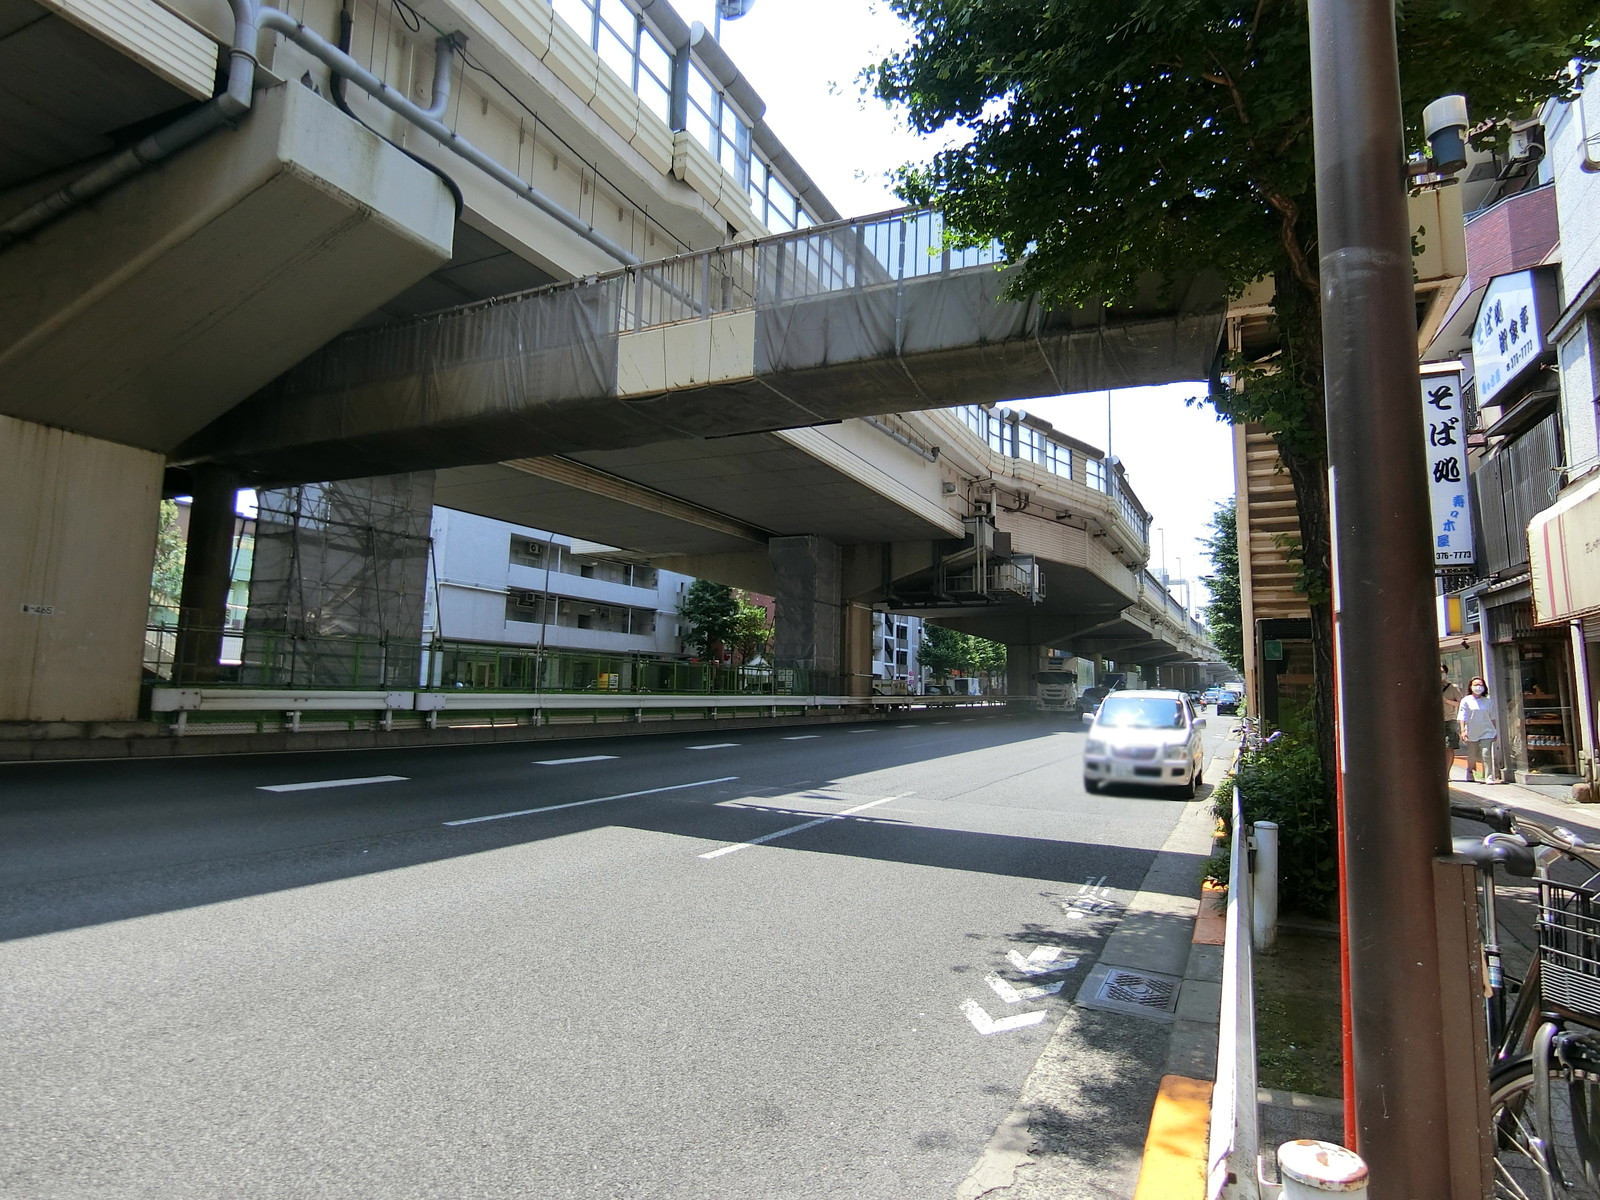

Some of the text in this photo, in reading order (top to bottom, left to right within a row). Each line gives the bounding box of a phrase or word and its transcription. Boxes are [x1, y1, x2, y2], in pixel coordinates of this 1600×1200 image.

[1476, 299, 1504, 346] そば処
[1499, 305, 1529, 356] 御食事
[1428, 386, 1461, 483] そば処
[1435, 551, 1472, 560] 376-7773
